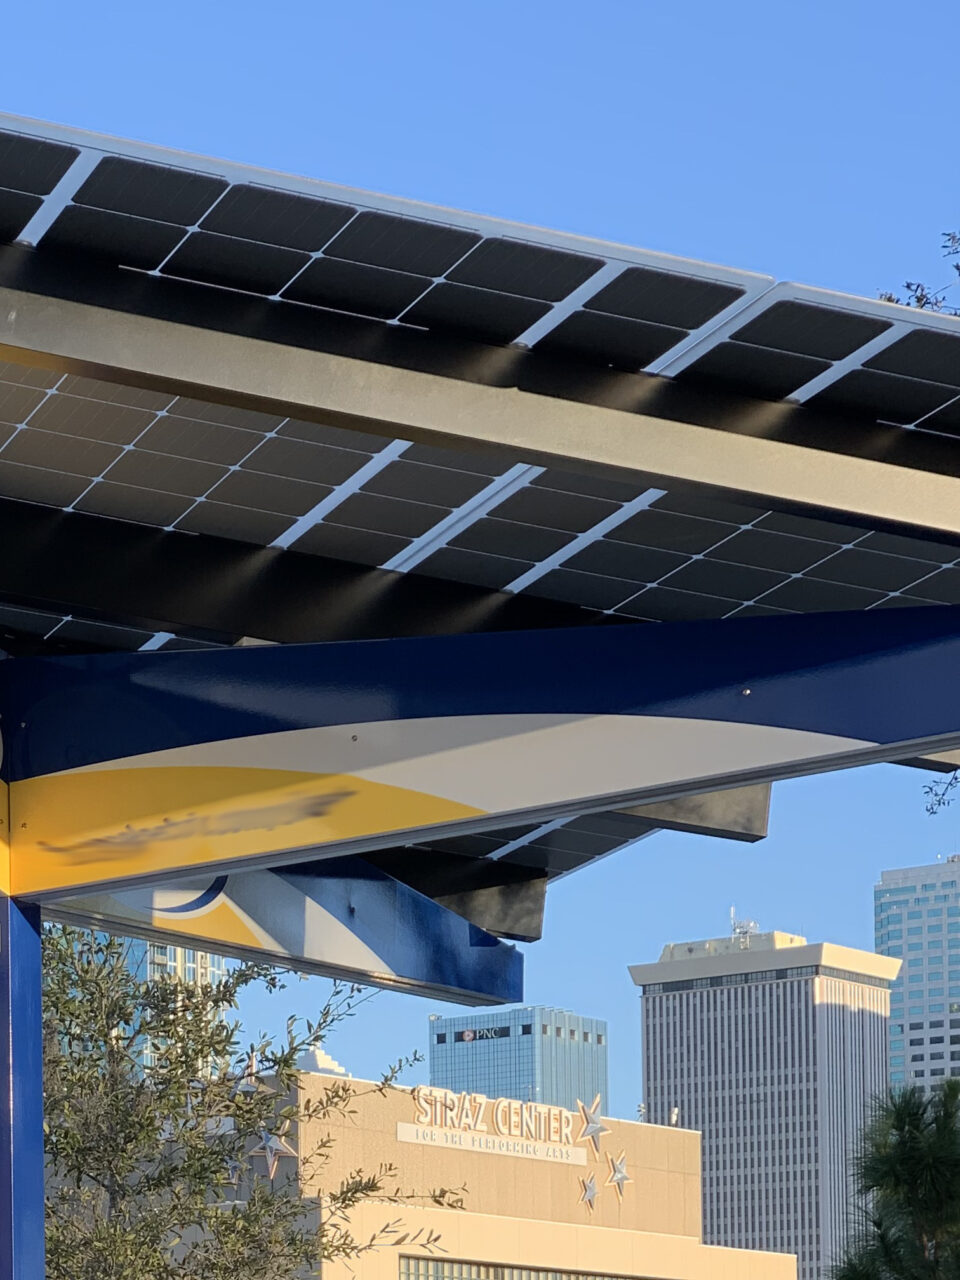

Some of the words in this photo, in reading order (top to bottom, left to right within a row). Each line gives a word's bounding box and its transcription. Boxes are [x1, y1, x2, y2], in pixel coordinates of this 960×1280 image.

[476, 1027, 500, 1041] PNC
[415, 1086, 488, 1132] STRAZ
[493, 1097, 574, 1147] CENTER
[415, 1128, 437, 1143] FOR
[444, 1132, 464, 1146] THE
[471, 1135, 540, 1157] PERFORMING
[545, 1148, 572, 1162] ARTS
